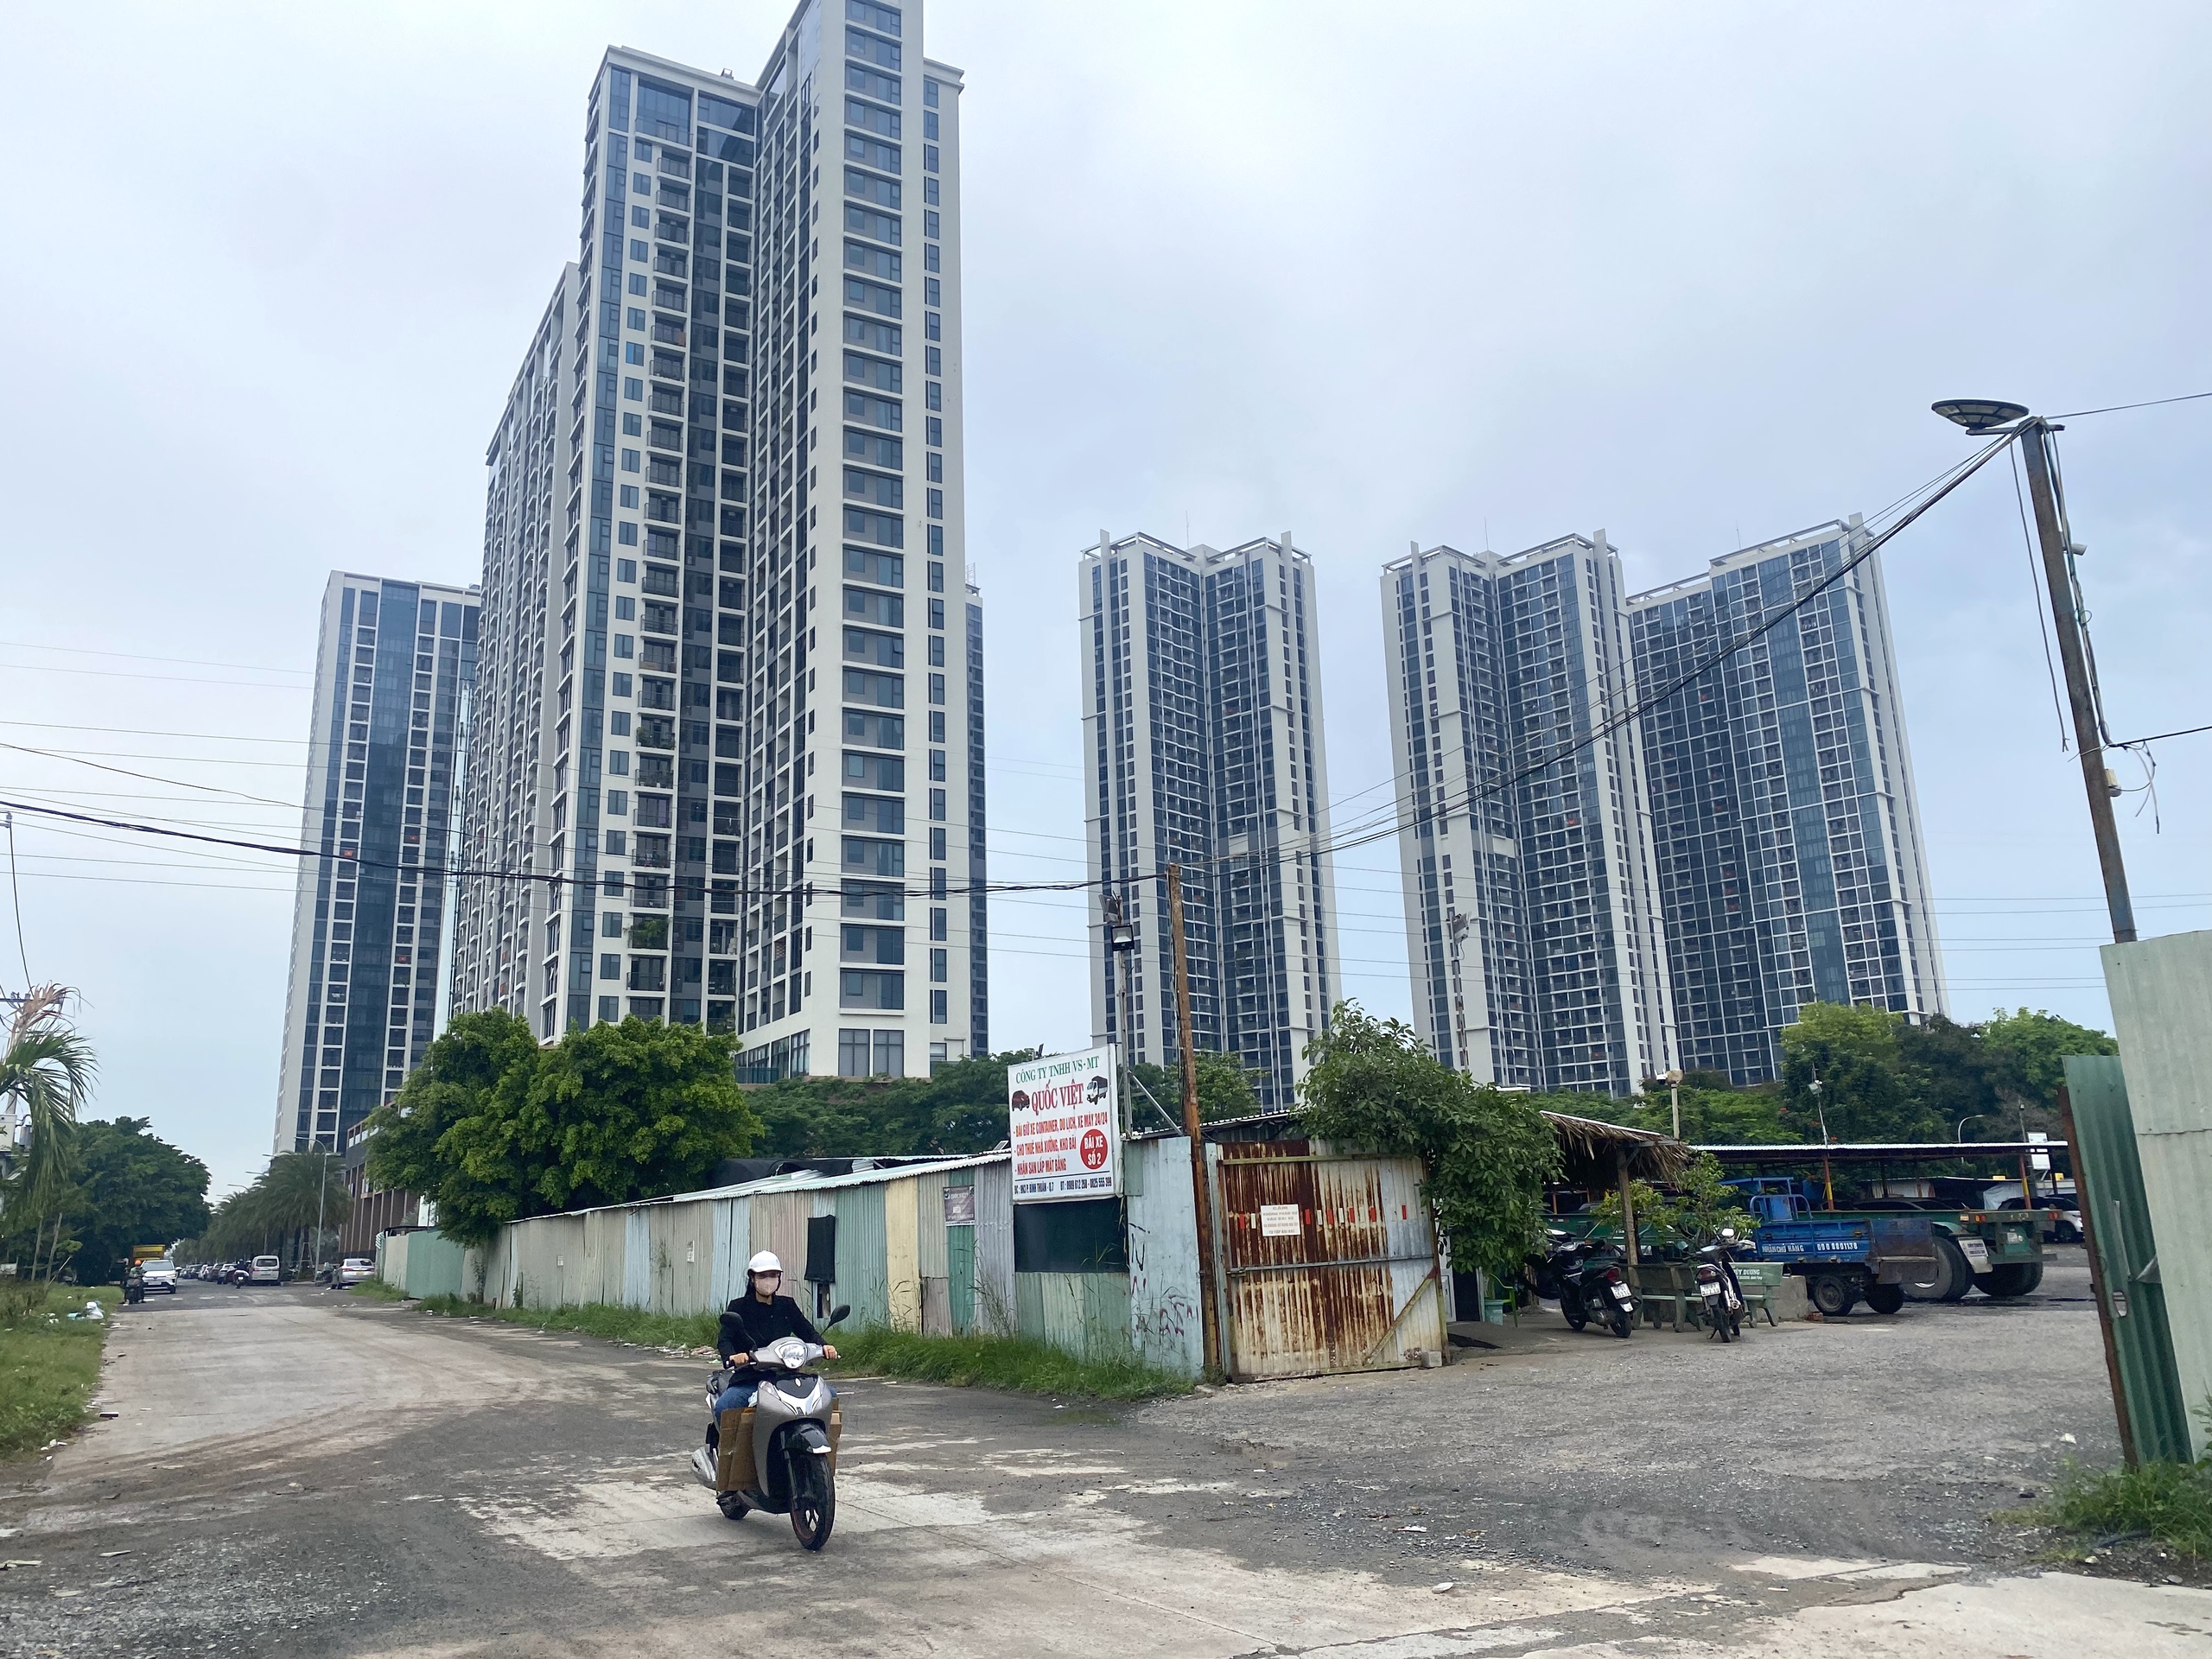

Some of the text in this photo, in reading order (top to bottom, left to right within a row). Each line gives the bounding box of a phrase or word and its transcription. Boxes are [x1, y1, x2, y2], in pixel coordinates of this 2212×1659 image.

[1016, 1068, 1036, 1084] CÔNG
[1038, 1067, 1047, 1079] TY
[1048, 1062, 1071, 1077] TNHH
[1032, 1078, 1084, 1116] QUỐC VIỆT
[1084, 1134, 1103, 1150] BÃI XE
[1087, 1148, 1102, 1166] SỐ 2
